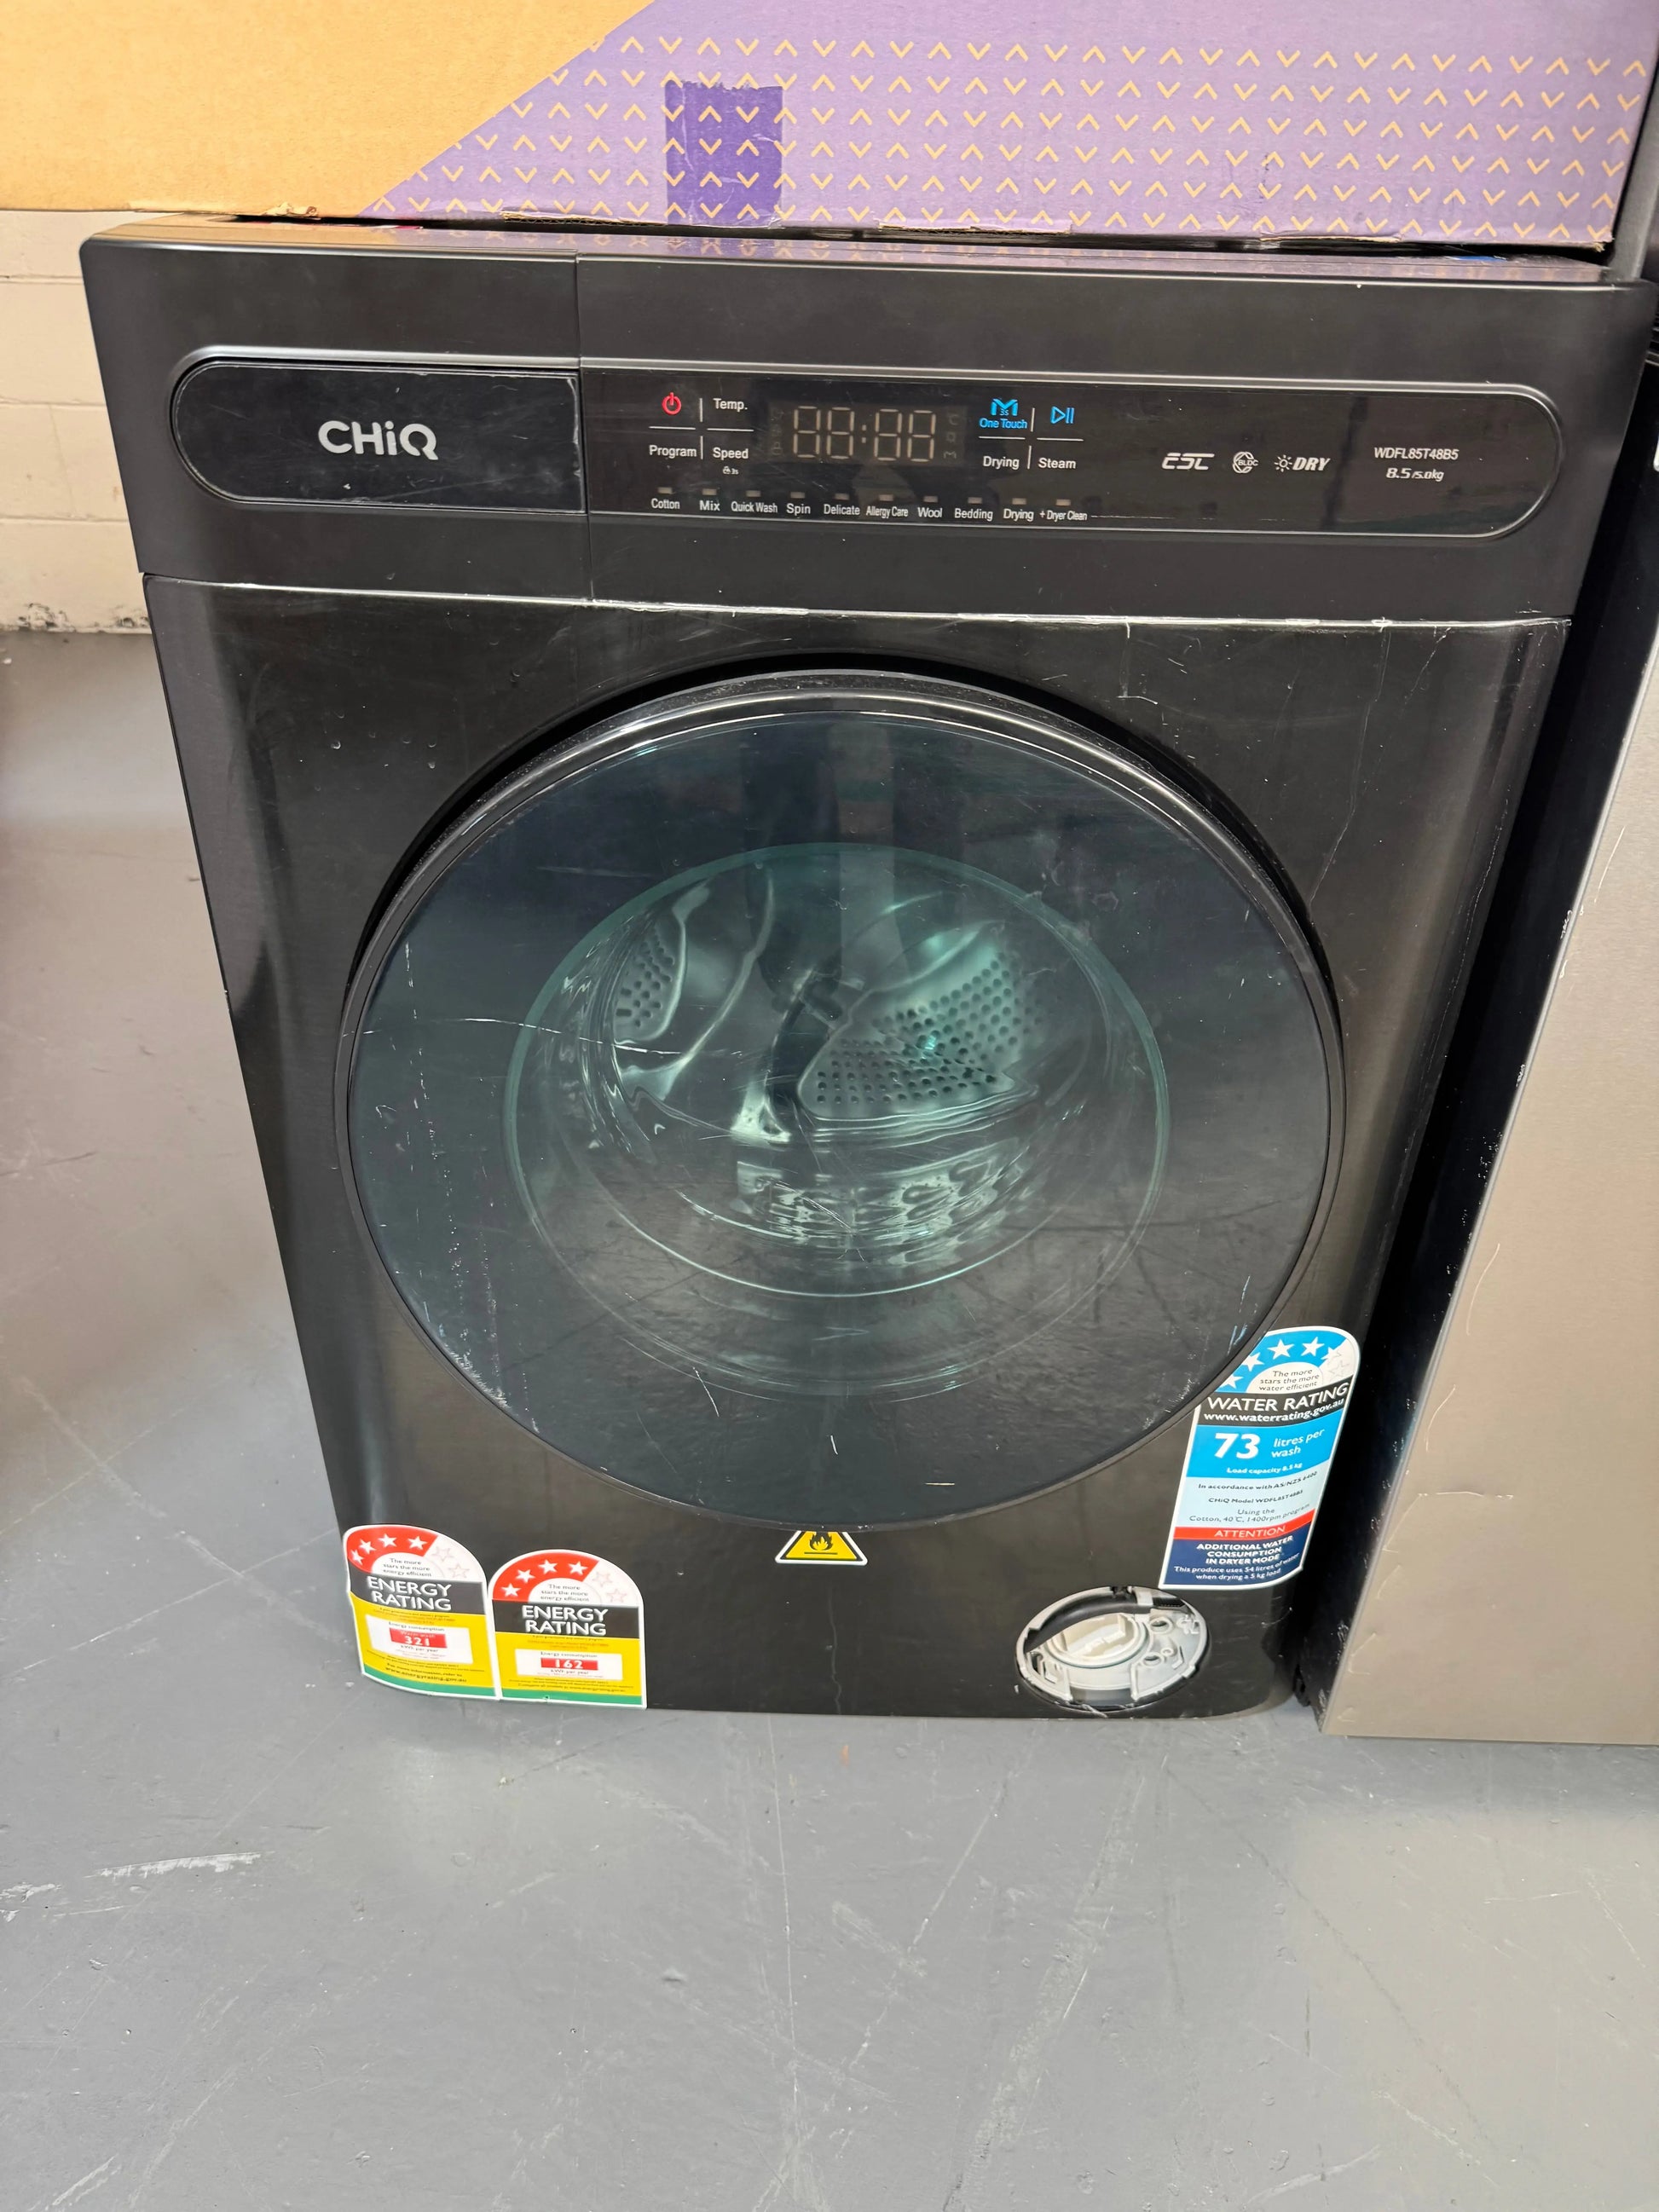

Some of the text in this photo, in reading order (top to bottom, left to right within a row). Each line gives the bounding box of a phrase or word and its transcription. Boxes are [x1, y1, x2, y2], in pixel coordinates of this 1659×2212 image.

[713, 398, 748, 412] Temp.
[979, 418, 1027, 429] One Touch
[318, 420, 438, 460] CHiQ
[649, 444, 697, 459] Program
[713, 447, 749, 460] Speed
[1374, 447, 1460, 460] WDFL85T48B5
[983, 455, 1020, 470] Drying
[1038, 457, 1076, 469] Steam
[1292, 457, 1331, 471] DRY
[651, 498, 680, 510] Cotton
[699, 500, 720, 511] Mix
[731, 501, 777, 513] Quick Wash
[786, 503, 811, 516] Spin
[824, 504, 860, 515] Delicate
[866, 505, 909, 519] Allergy Care
[917, 507, 943, 518] Wool
[954, 508, 993, 521] Bedding
[1003, 508, 1034, 521] Drying
[1047, 510, 1066, 522] Dryer
[1066, 511, 1087, 521] Clean
[1286, 1382, 1317, 1391] efficient
[1207, 1383, 1350, 1412] WATER RATING
[1204, 1398, 1344, 1423] www.waterrating.gov.au
[1273, 1429, 1325, 1448] litres per
[1214, 1432, 1260, 1459] 73
[1271, 1446, 1301, 1458] wash
[1248, 1466, 1280, 1475] capacity
[1214, 1525, 1286, 1538] ATTENTION
[1263, 1535, 1294, 1548] WATER
[1207, 1547, 1282, 1558] CONSUMPTION
[1252, 1554, 1280, 1564] MODE
[1266, 1568, 1281, 1577] load
[367, 1575, 452, 1597] ENERGY
[371, 1591, 452, 1611] RATING
[522, 1604, 609, 1622] ENERGY
[525, 1620, 607, 1636] RATING
[404, 1636, 431, 1647] 321
[555, 1659, 584, 1669] 162
